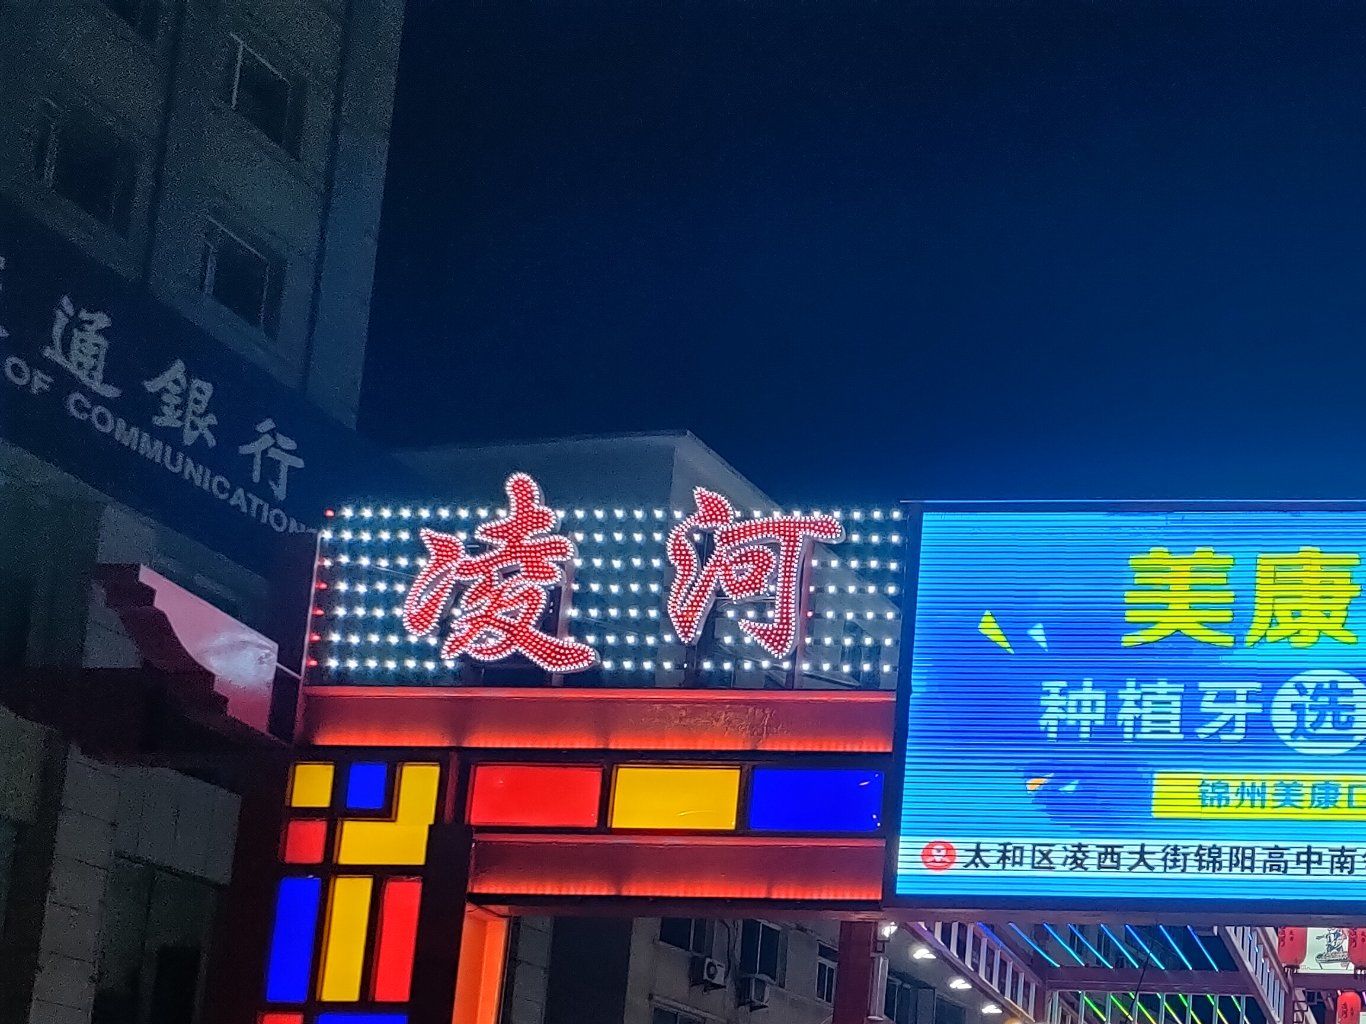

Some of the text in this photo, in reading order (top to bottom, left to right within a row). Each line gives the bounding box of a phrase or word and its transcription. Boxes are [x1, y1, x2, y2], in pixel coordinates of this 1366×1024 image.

[0, 257, 304, 501] 通銀行
[4, 355, 318, 534] OF COMMUNICATION
